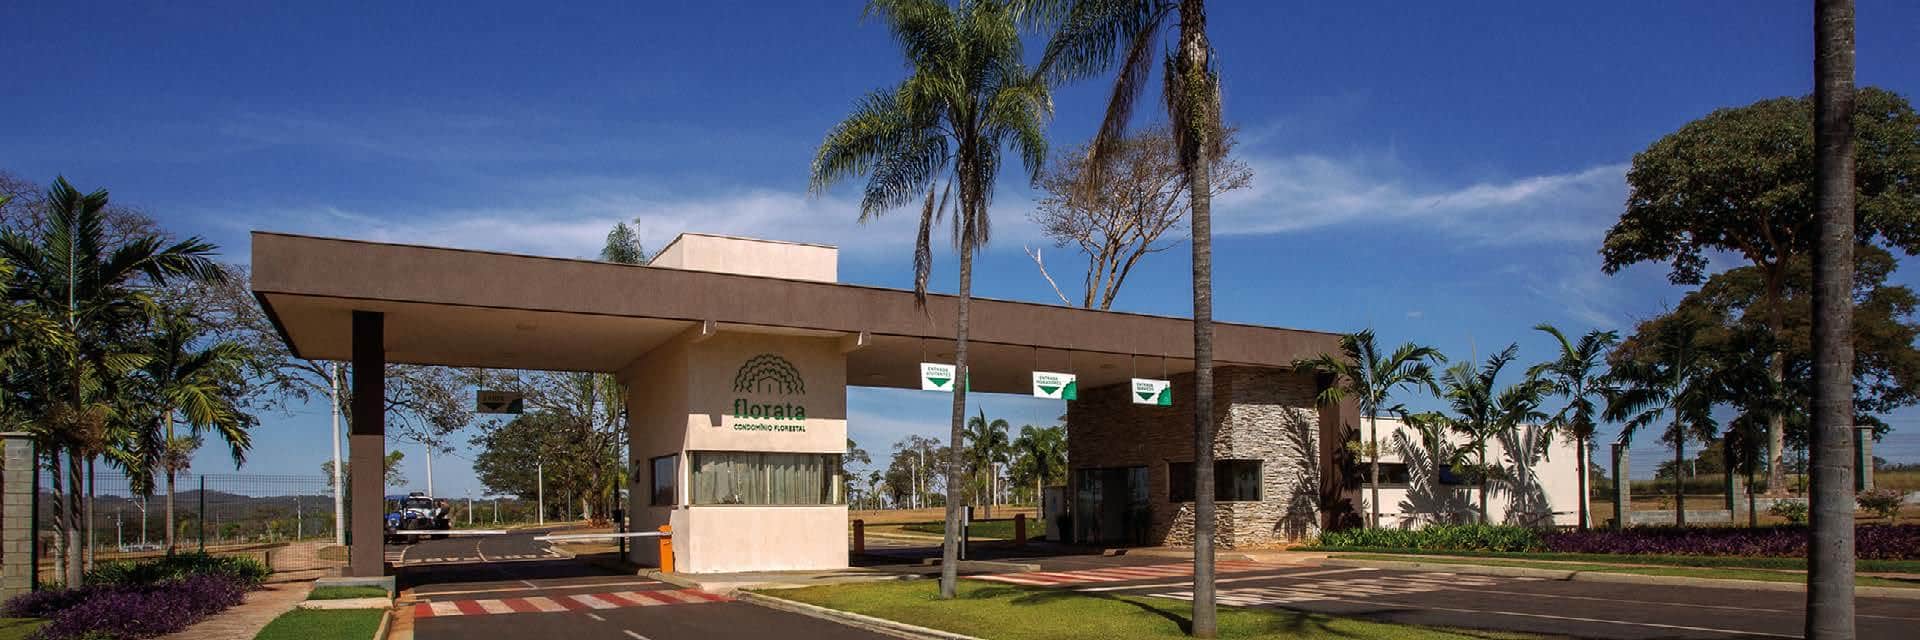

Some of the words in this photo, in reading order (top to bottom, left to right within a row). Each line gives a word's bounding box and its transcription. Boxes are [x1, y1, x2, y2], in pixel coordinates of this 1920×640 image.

[734, 398, 806, 420] florata
[734, 423, 773, 432] CONDOMÍNIO
[774, 424, 806, 432] FLORESTAL
